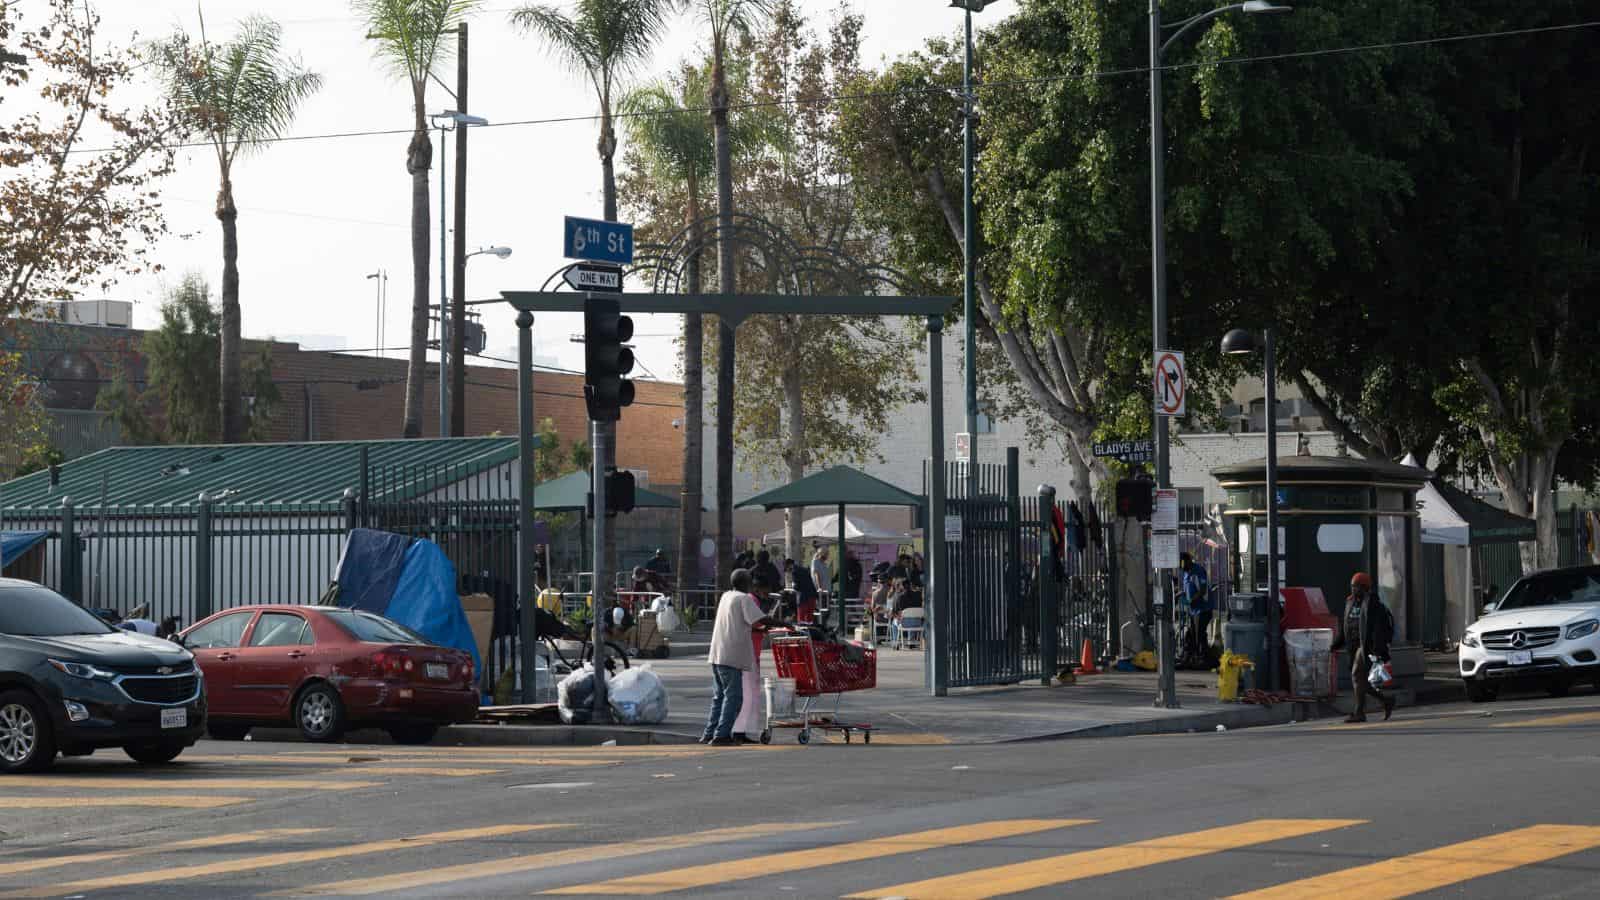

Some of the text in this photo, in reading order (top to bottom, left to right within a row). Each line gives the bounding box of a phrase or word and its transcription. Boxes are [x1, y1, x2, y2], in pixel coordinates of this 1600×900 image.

[574, 225, 625, 253] 6th St
[580, 272, 617, 286] ONE WAY
[1095, 440, 1153, 455] GLADYS AVE
